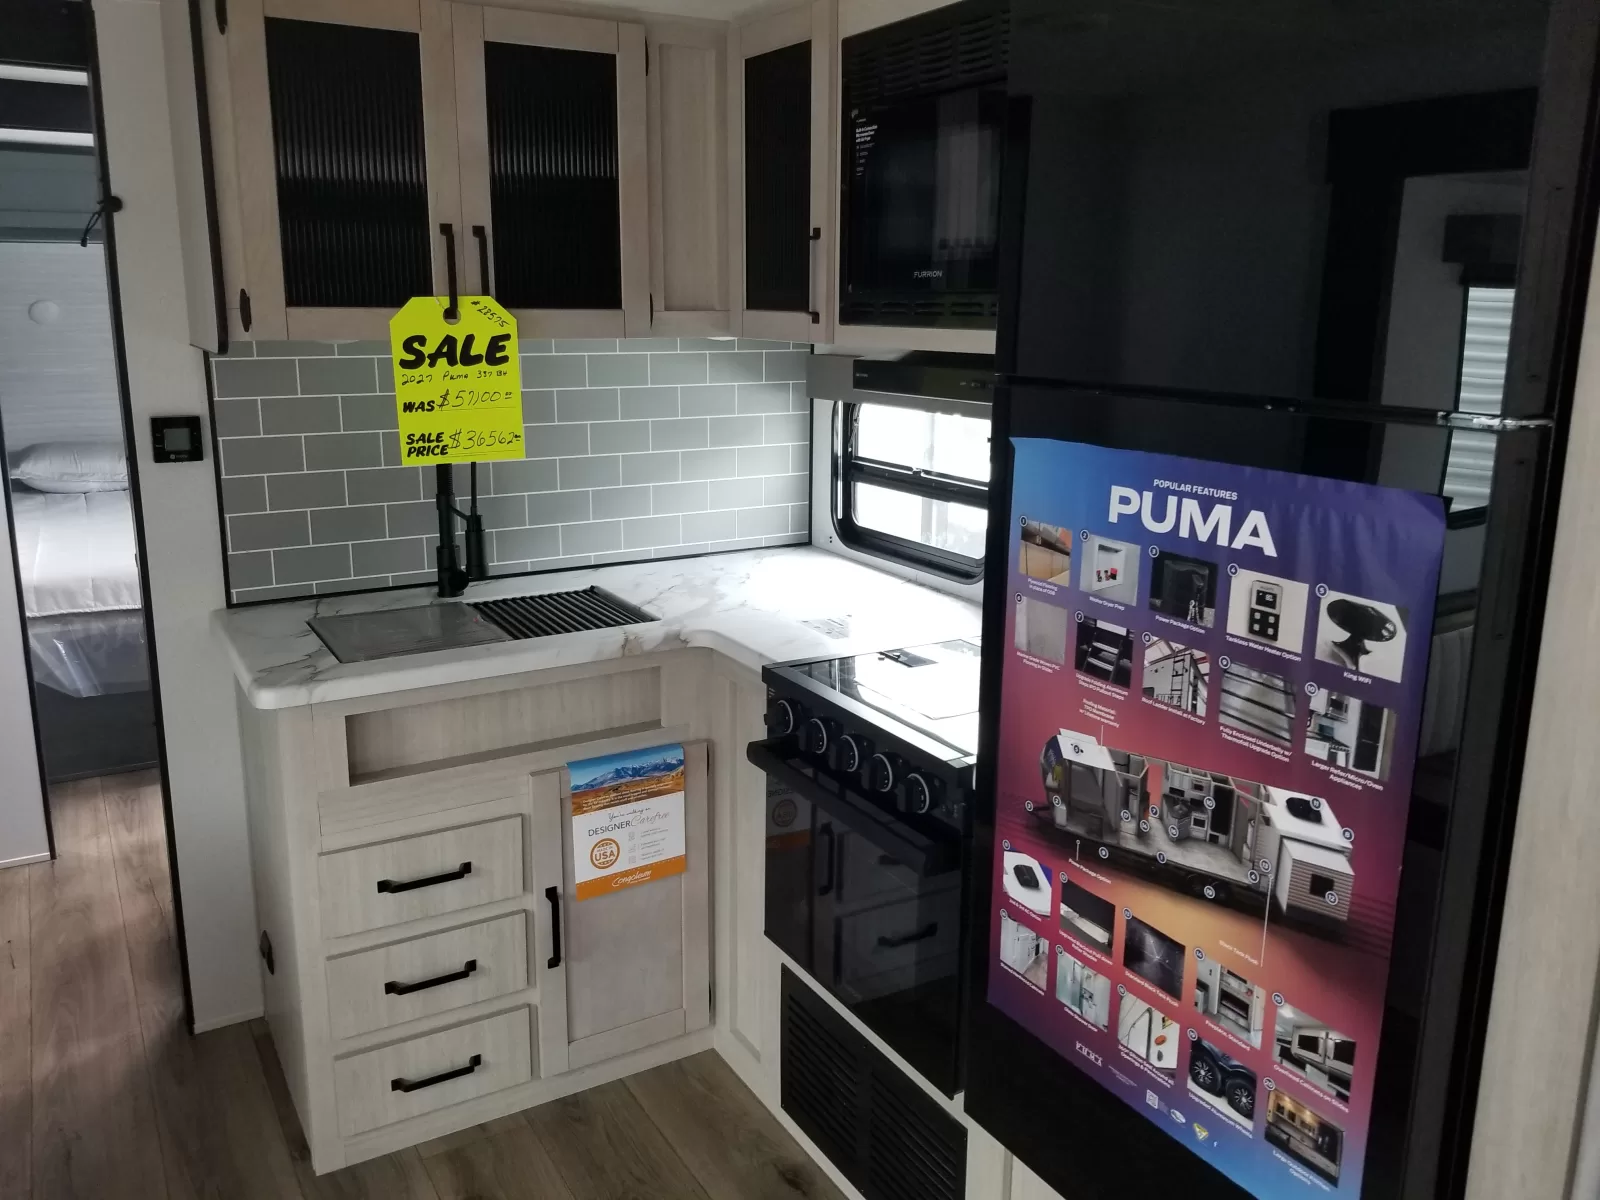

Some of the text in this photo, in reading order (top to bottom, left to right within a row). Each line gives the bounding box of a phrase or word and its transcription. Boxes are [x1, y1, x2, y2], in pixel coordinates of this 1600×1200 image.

[914, 270, 942, 278] FURRION
[399, 334, 511, 370] SALE
[403, 400, 436, 413] WAS
[406, 432, 444, 445] SALE
[407, 444, 449, 458] PRICE
[1153, 478, 1238, 500] POPULAR FEATURES
[1108, 484, 1278, 558] PUMA
[1102, 600, 1114, 608] Dryer
[1155, 614, 1205, 634] Power Package Option
[1225, 634, 1301, 662] Tankless Water Heater Option
[1343, 670, 1357, 681] King
[1152, 701, 1167, 710] Ladder
[1187, 714, 1205, 726] Factory
[1219, 725, 1232, 735] Fully
[1232, 730, 1256, 743] Enclosed
[1256, 738, 1283, 754] Underbelly
[1249, 742, 1270, 756] Upgrade
[1270, 750, 1289, 762] Option
[1311, 759, 1329, 772] Larger
[1328, 773, 1362, 791] Appliances
[588, 820, 630, 836] DESIGNER
[630, 812, 670, 826] Carefree
[594, 850, 616, 862] USA
